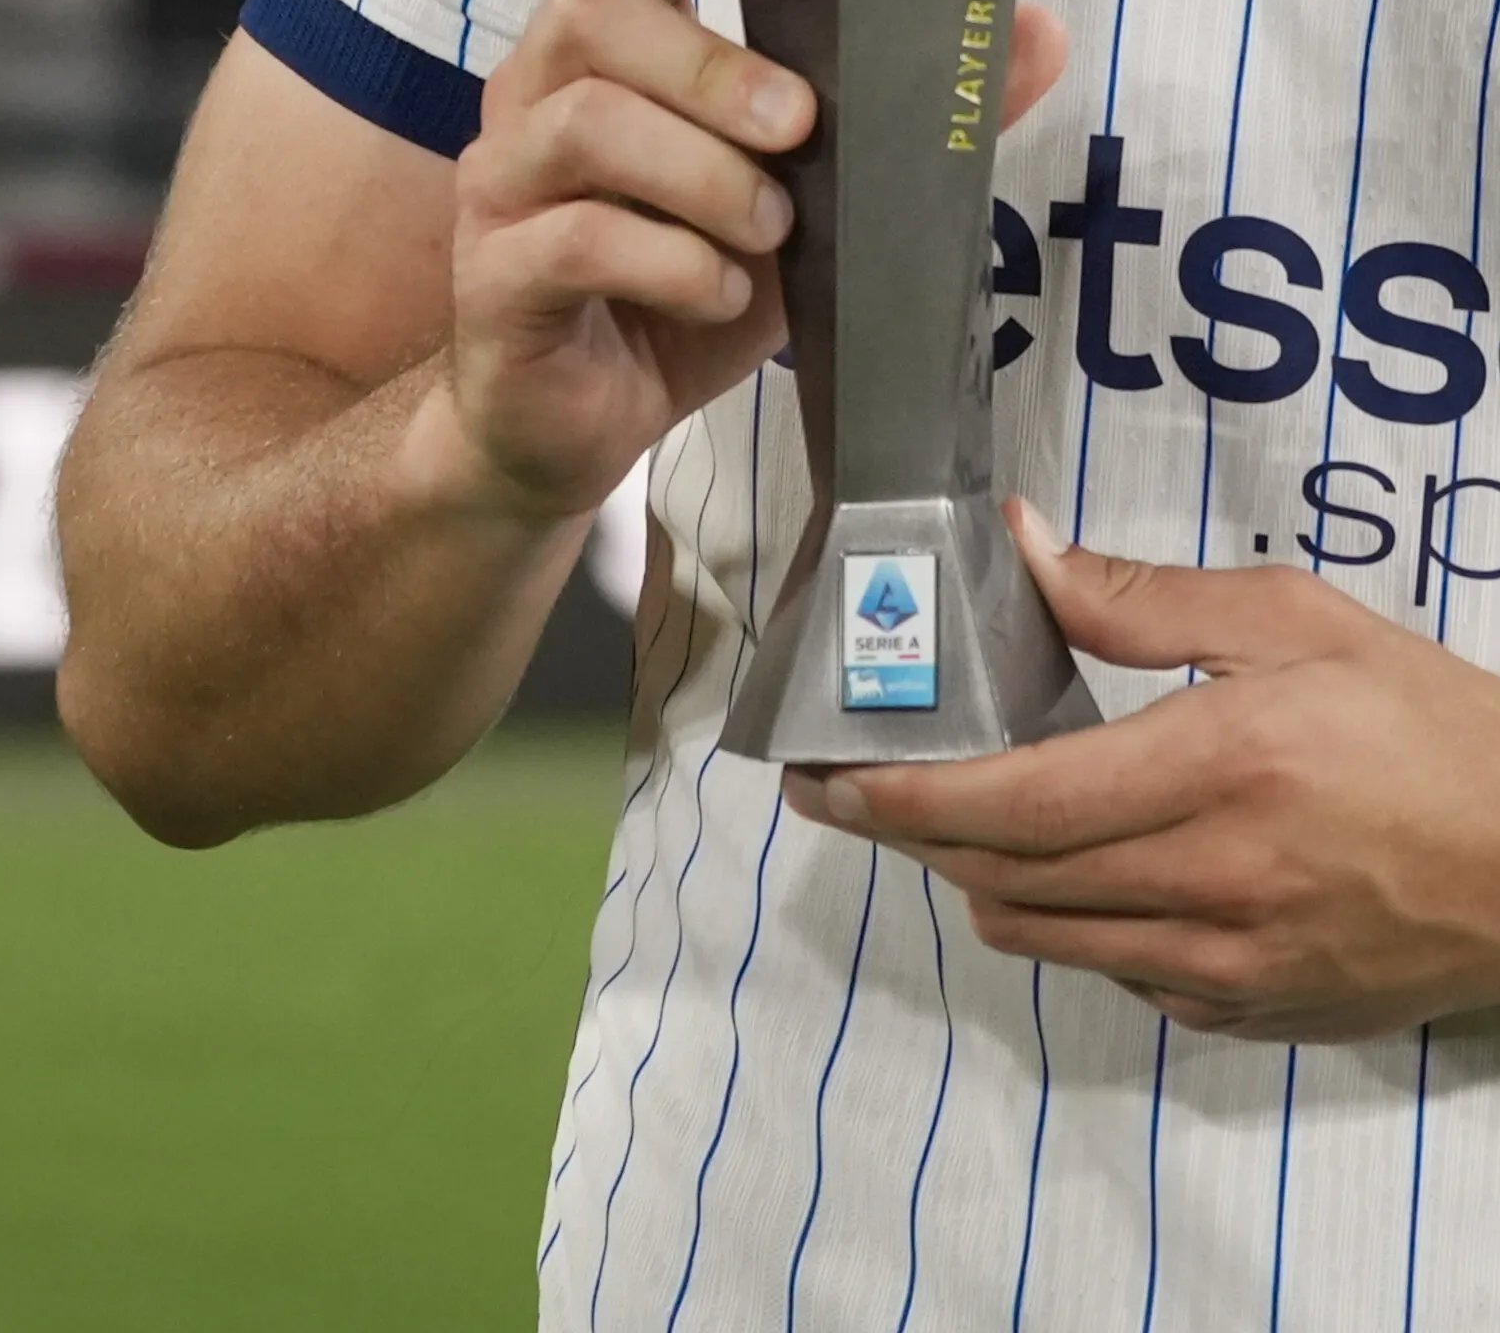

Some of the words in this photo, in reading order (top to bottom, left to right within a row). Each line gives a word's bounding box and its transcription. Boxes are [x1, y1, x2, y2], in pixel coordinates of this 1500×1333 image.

[947, 0, 996, 152] PLAYER
[855, 636, 903, 651] SERIE
[908, 636, 920, 650] A
